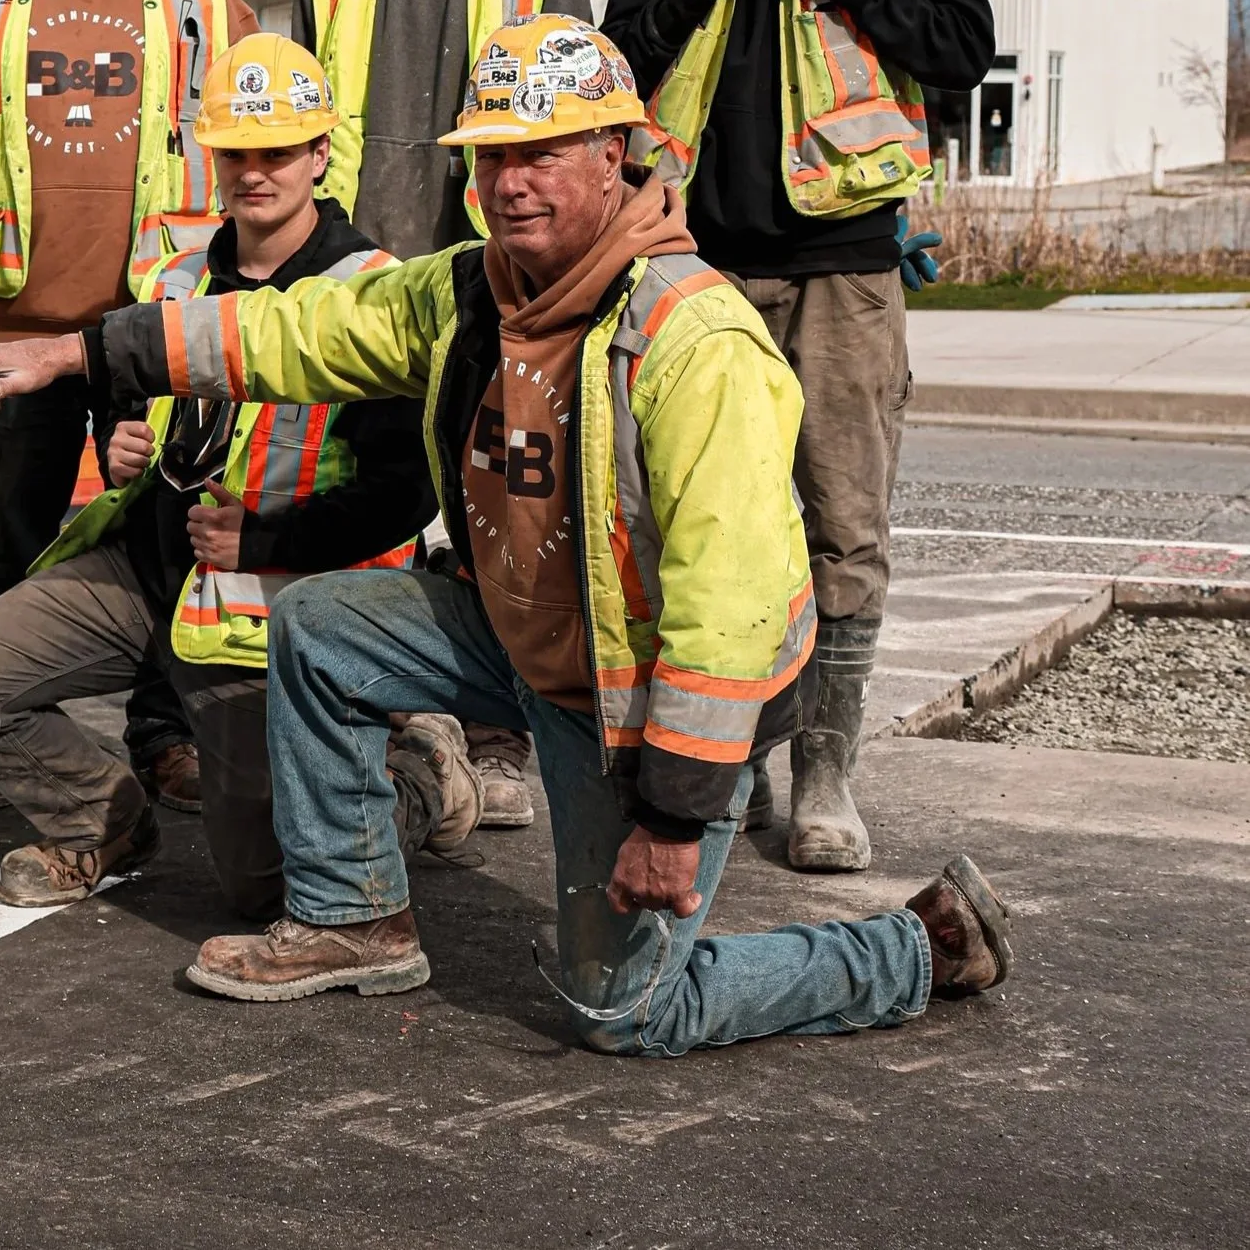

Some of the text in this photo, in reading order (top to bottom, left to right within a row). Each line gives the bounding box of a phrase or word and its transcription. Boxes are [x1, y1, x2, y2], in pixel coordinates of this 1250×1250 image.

[46, 10, 146, 54] CONTRACTIN
[27, 51, 138, 97] B&B
[492, 70, 518, 83] B&B
[485, 98, 510, 111] B&B
[25, 108, 142, 154] OUP EST. 194
